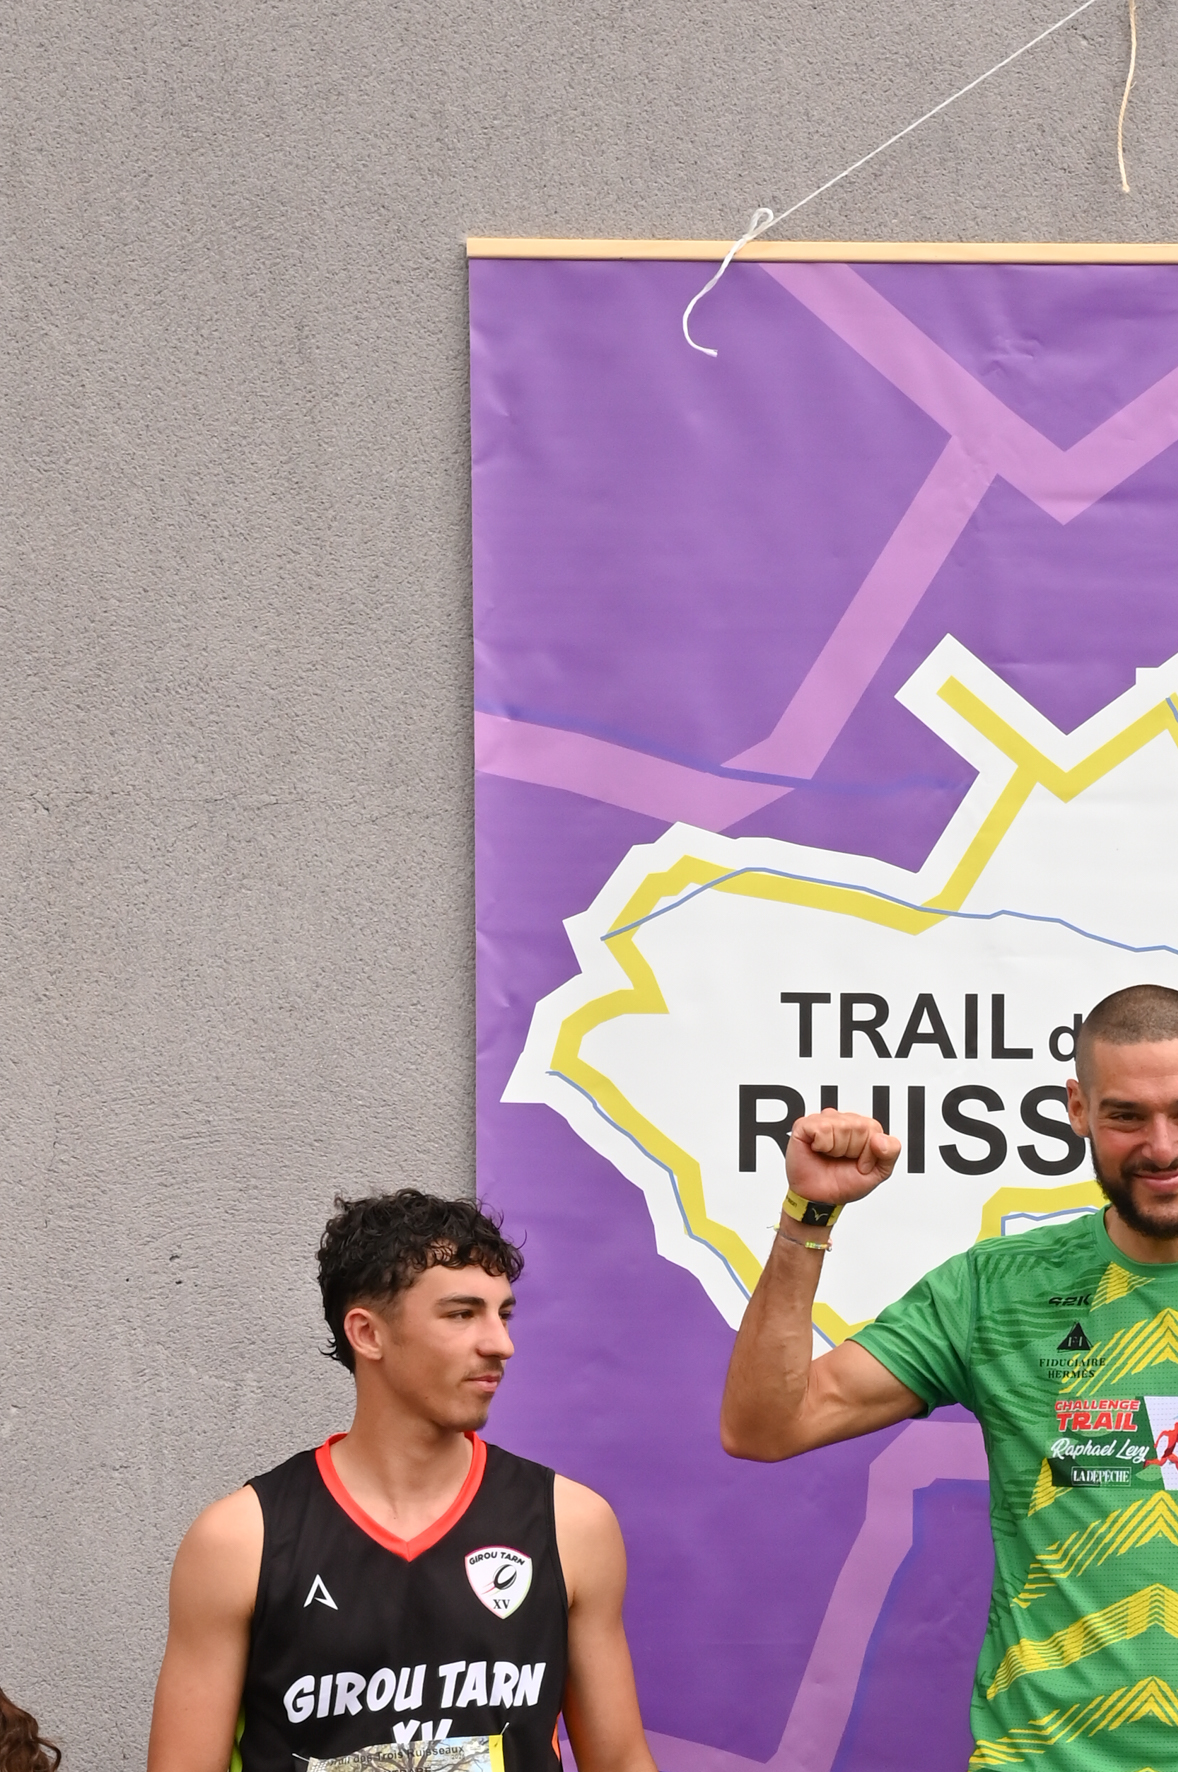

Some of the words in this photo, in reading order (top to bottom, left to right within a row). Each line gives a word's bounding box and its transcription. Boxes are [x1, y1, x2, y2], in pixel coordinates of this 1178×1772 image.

[780, 992, 1033, 1059] TRAIL
[1039, 1358, 1106, 1367] FIDUCIAIRE
[1055, 1399, 1140, 1411] CHALLENGE
[1056, 1412, 1138, 1432] TRAIL
[469, 1551, 498, 1565] GIROU
[500, 1552, 526, 1566] TARN
[493, 1599, 510, 1609] XV
[283, 1664, 428, 1724] GIROU
[438, 1660, 547, 1711] TARN
[376, 1751, 403, 1760] Trois
[407, 1745, 465, 1758] Ruisseaux
